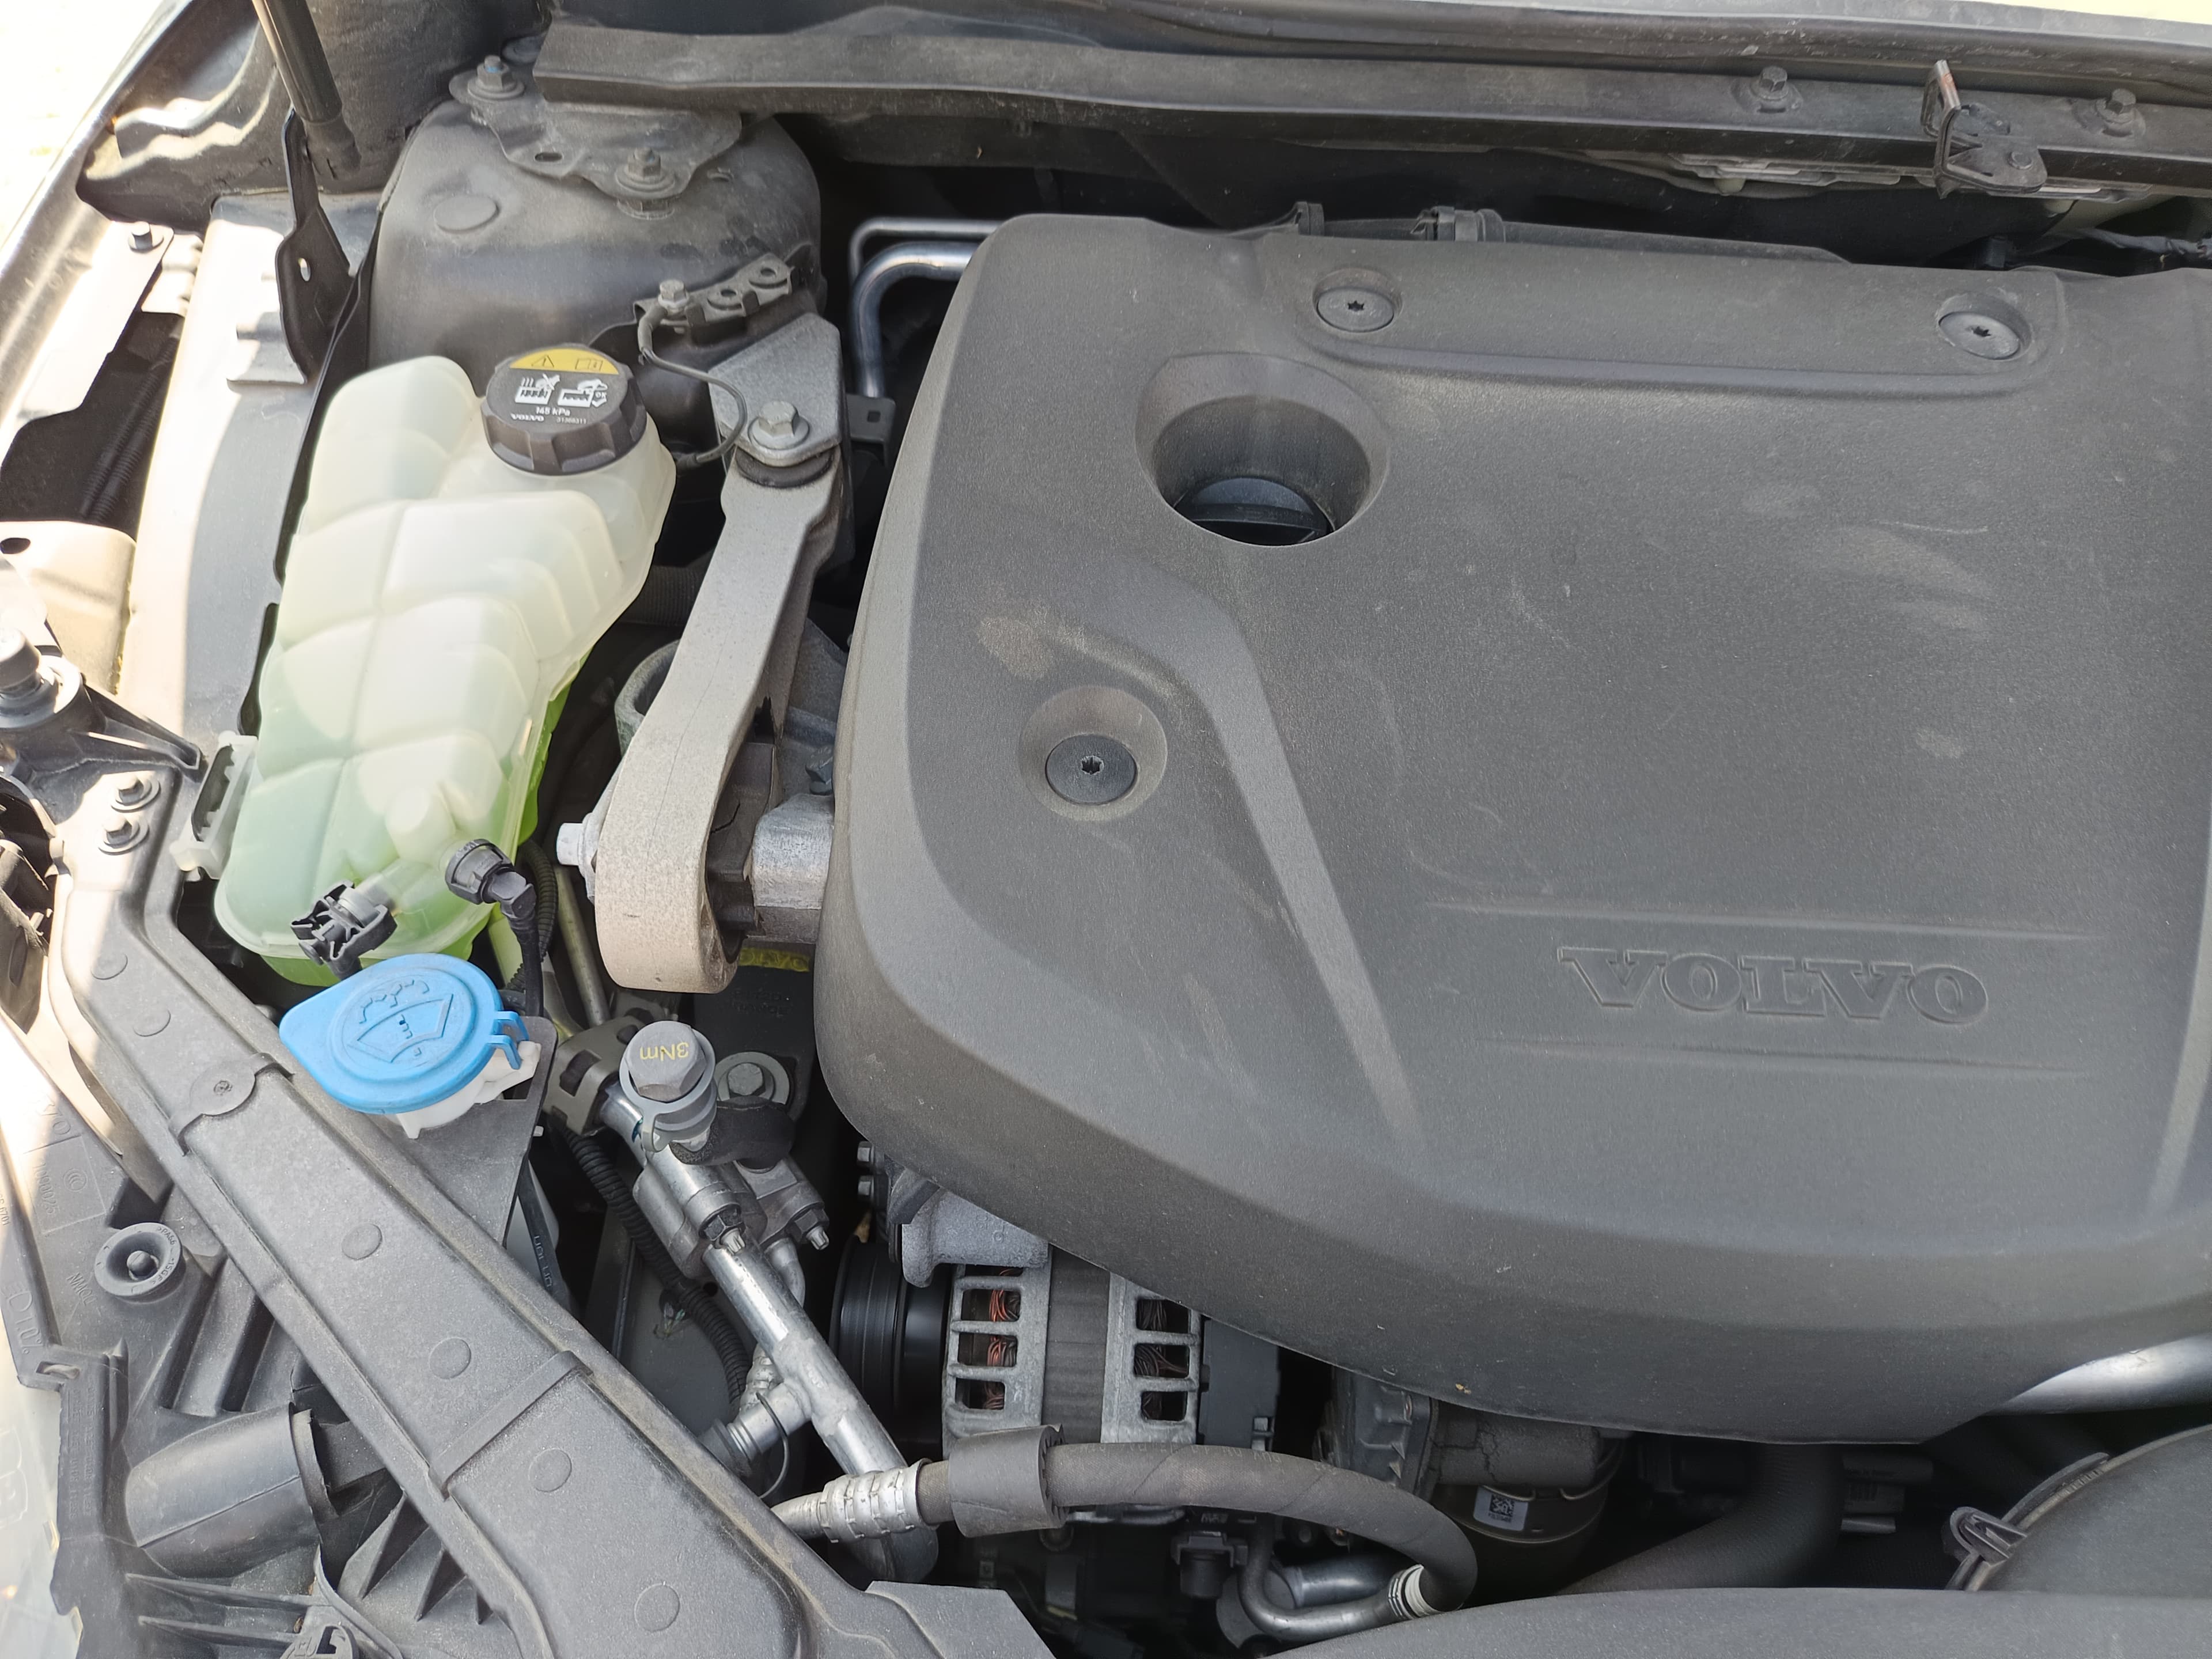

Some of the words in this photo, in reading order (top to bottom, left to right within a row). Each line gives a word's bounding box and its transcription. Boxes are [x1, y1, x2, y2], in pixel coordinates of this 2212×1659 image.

[510, 413, 544, 422] VOLVO
[552, 407, 571, 416] kPa
[1557, 946, 1988, 1025] VOLVO
[639, 1042, 690, 1061] 3Nm
